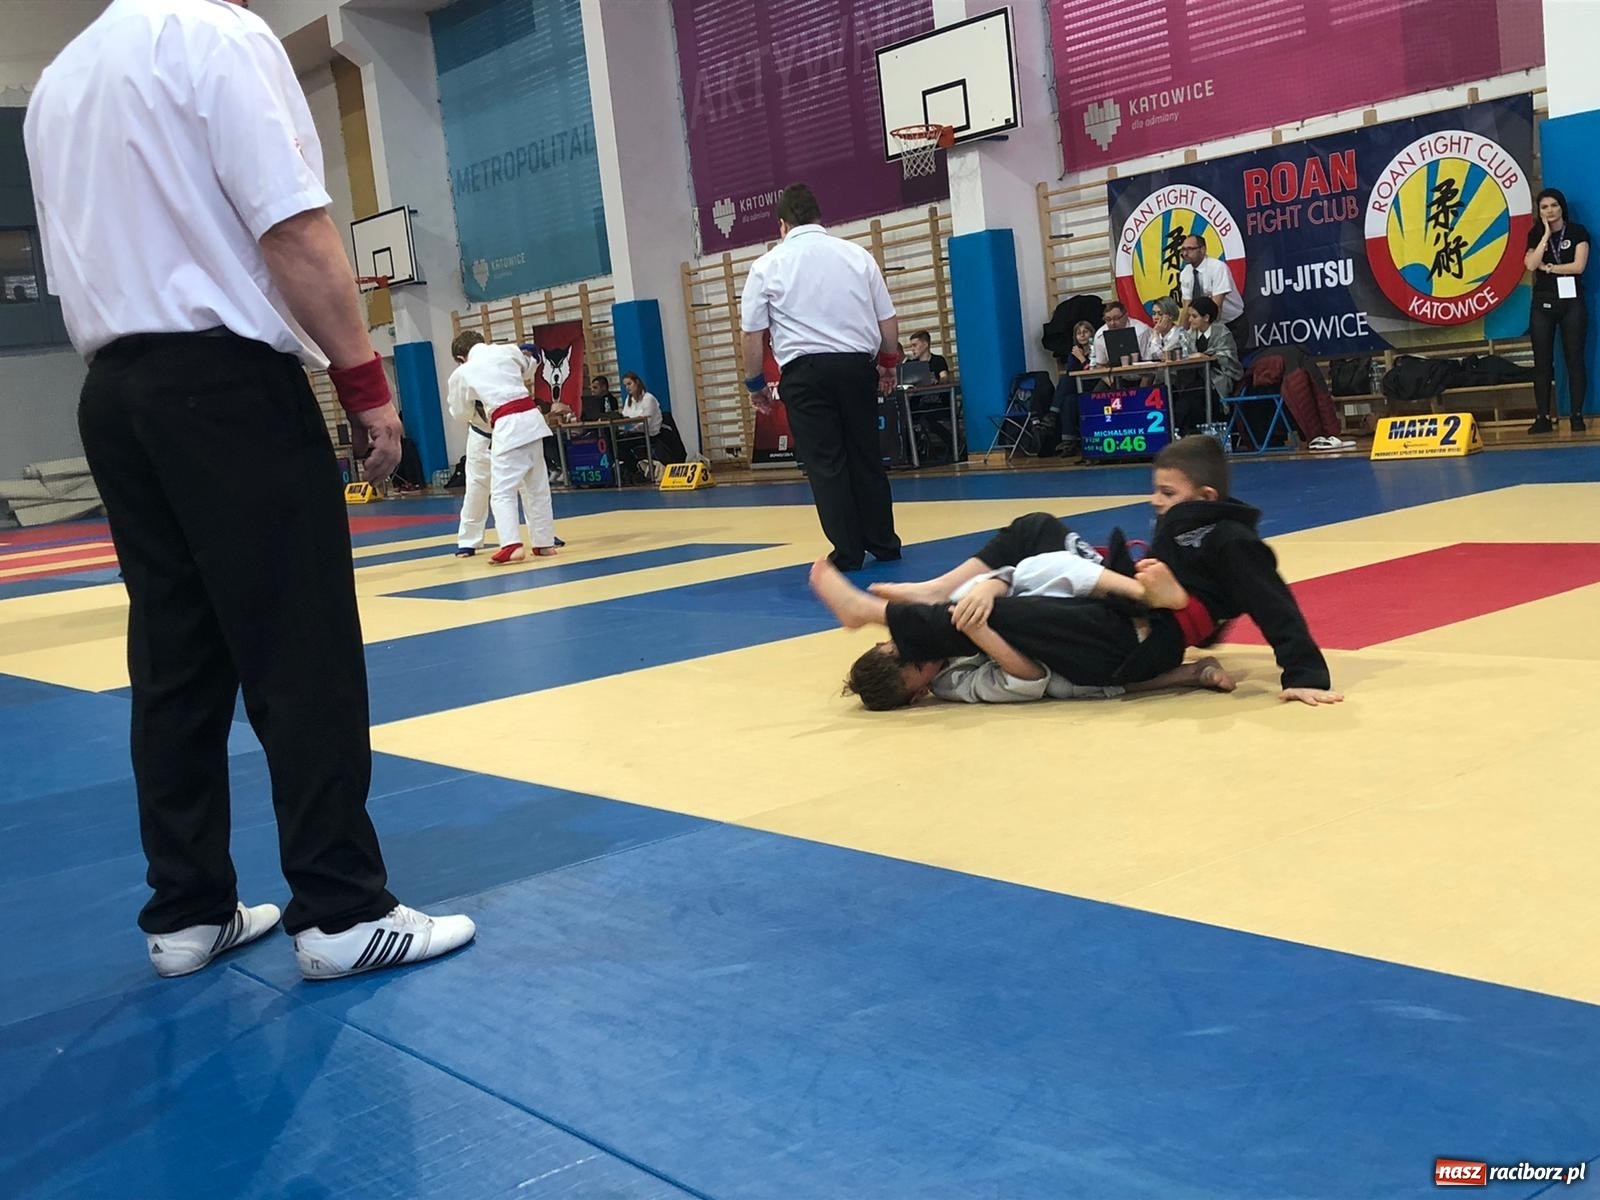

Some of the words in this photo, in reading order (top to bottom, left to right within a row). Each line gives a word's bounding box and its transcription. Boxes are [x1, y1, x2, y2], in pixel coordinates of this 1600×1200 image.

[1129, 80, 1215, 116] KATOWICE
[1243, 149, 1358, 209] ROAN
[1372, 152, 1417, 213] ROAN
[1418, 135, 1473, 161] FIGHT
[1477, 143, 1519, 190] CLUB
[740, 189, 785, 212] KATOWIC
[1121, 203, 1154, 255] ROAN
[1155, 189, 1198, 211] FIGHT
[1200, 196, 1232, 237] CLUB
[1247, 204, 1302, 235] FIGHT
[1307, 194, 1360, 225] CLUB
[1260, 258, 1354, 297] JU-JITSU
[1408, 286, 1499, 320] KATOWICE
[1254, 312, 1369, 347] KATOWICE
[1111, 398, 1122, 410] 4
[1145, 388, 1164, 409] 4
[1094, 429, 1136, 437] MICHALSKI
[1146, 411, 1165, 433] 2
[1388, 418, 1438, 440] MATA
[1440, 415, 1461, 446] 2
[1103, 436, 1147, 453] 0:46
[1471, 423, 1478, 444] 2
[598, 439, 606, 453] 0
[600, 454, 609, 469] 4
[669, 465, 690, 478] MATA
[686, 465, 697, 484] 3
[701, 468, 709, 482] 3
